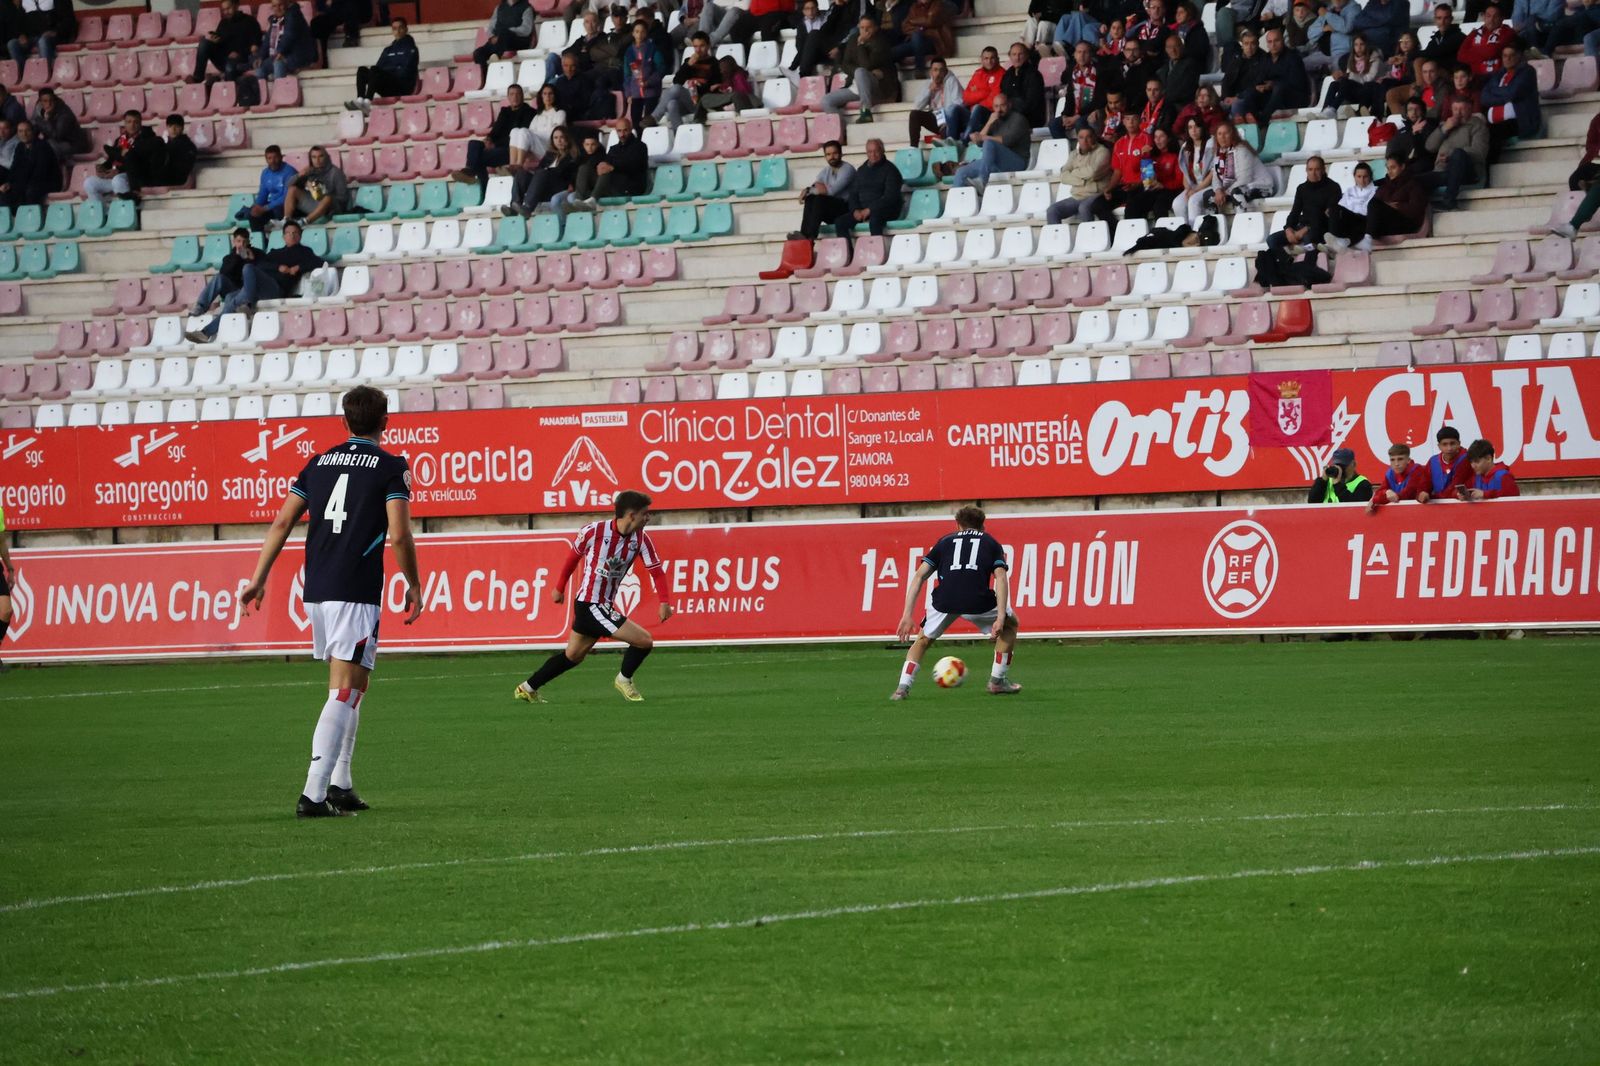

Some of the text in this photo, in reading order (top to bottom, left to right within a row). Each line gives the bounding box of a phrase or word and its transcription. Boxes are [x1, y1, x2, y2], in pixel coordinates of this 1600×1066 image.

[640, 403, 840, 444] Clínica Dental
[860, 409, 907, 423] Donantes
[908, 407, 921, 421] de
[1364, 366, 1600, 466] CAJA
[381, 427, 440, 445] SGUACES
[848, 431, 881, 448] Sangre
[899, 428, 924, 443] Local
[926, 428, 934, 442] A
[947, 414, 1083, 447] CARPINTERÍA
[25, 450, 44, 468] sgc
[167, 444, 186, 463] sgc
[296, 440, 316, 458] sgc
[849, 452, 894, 466] ZAMORA
[990, 445, 1083, 468] HIJOS DE
[316, 452, 380, 469] DUÑABEITIA
[849, 473, 910, 487] 980 04 96 23
[95, 474, 208, 511] sangregorio
[417, 490, 428, 502] DE
[430, 487, 477, 502] VEHÍCULOS
[543, 490, 566, 507] El
[323, 473, 350, 534] 4
[949, 537, 981, 571] 11
[1396, 526, 1600, 599] FEDERACI
[46, 578, 251, 630] INNOVA Chef
[463, 567, 548, 621] Chef
